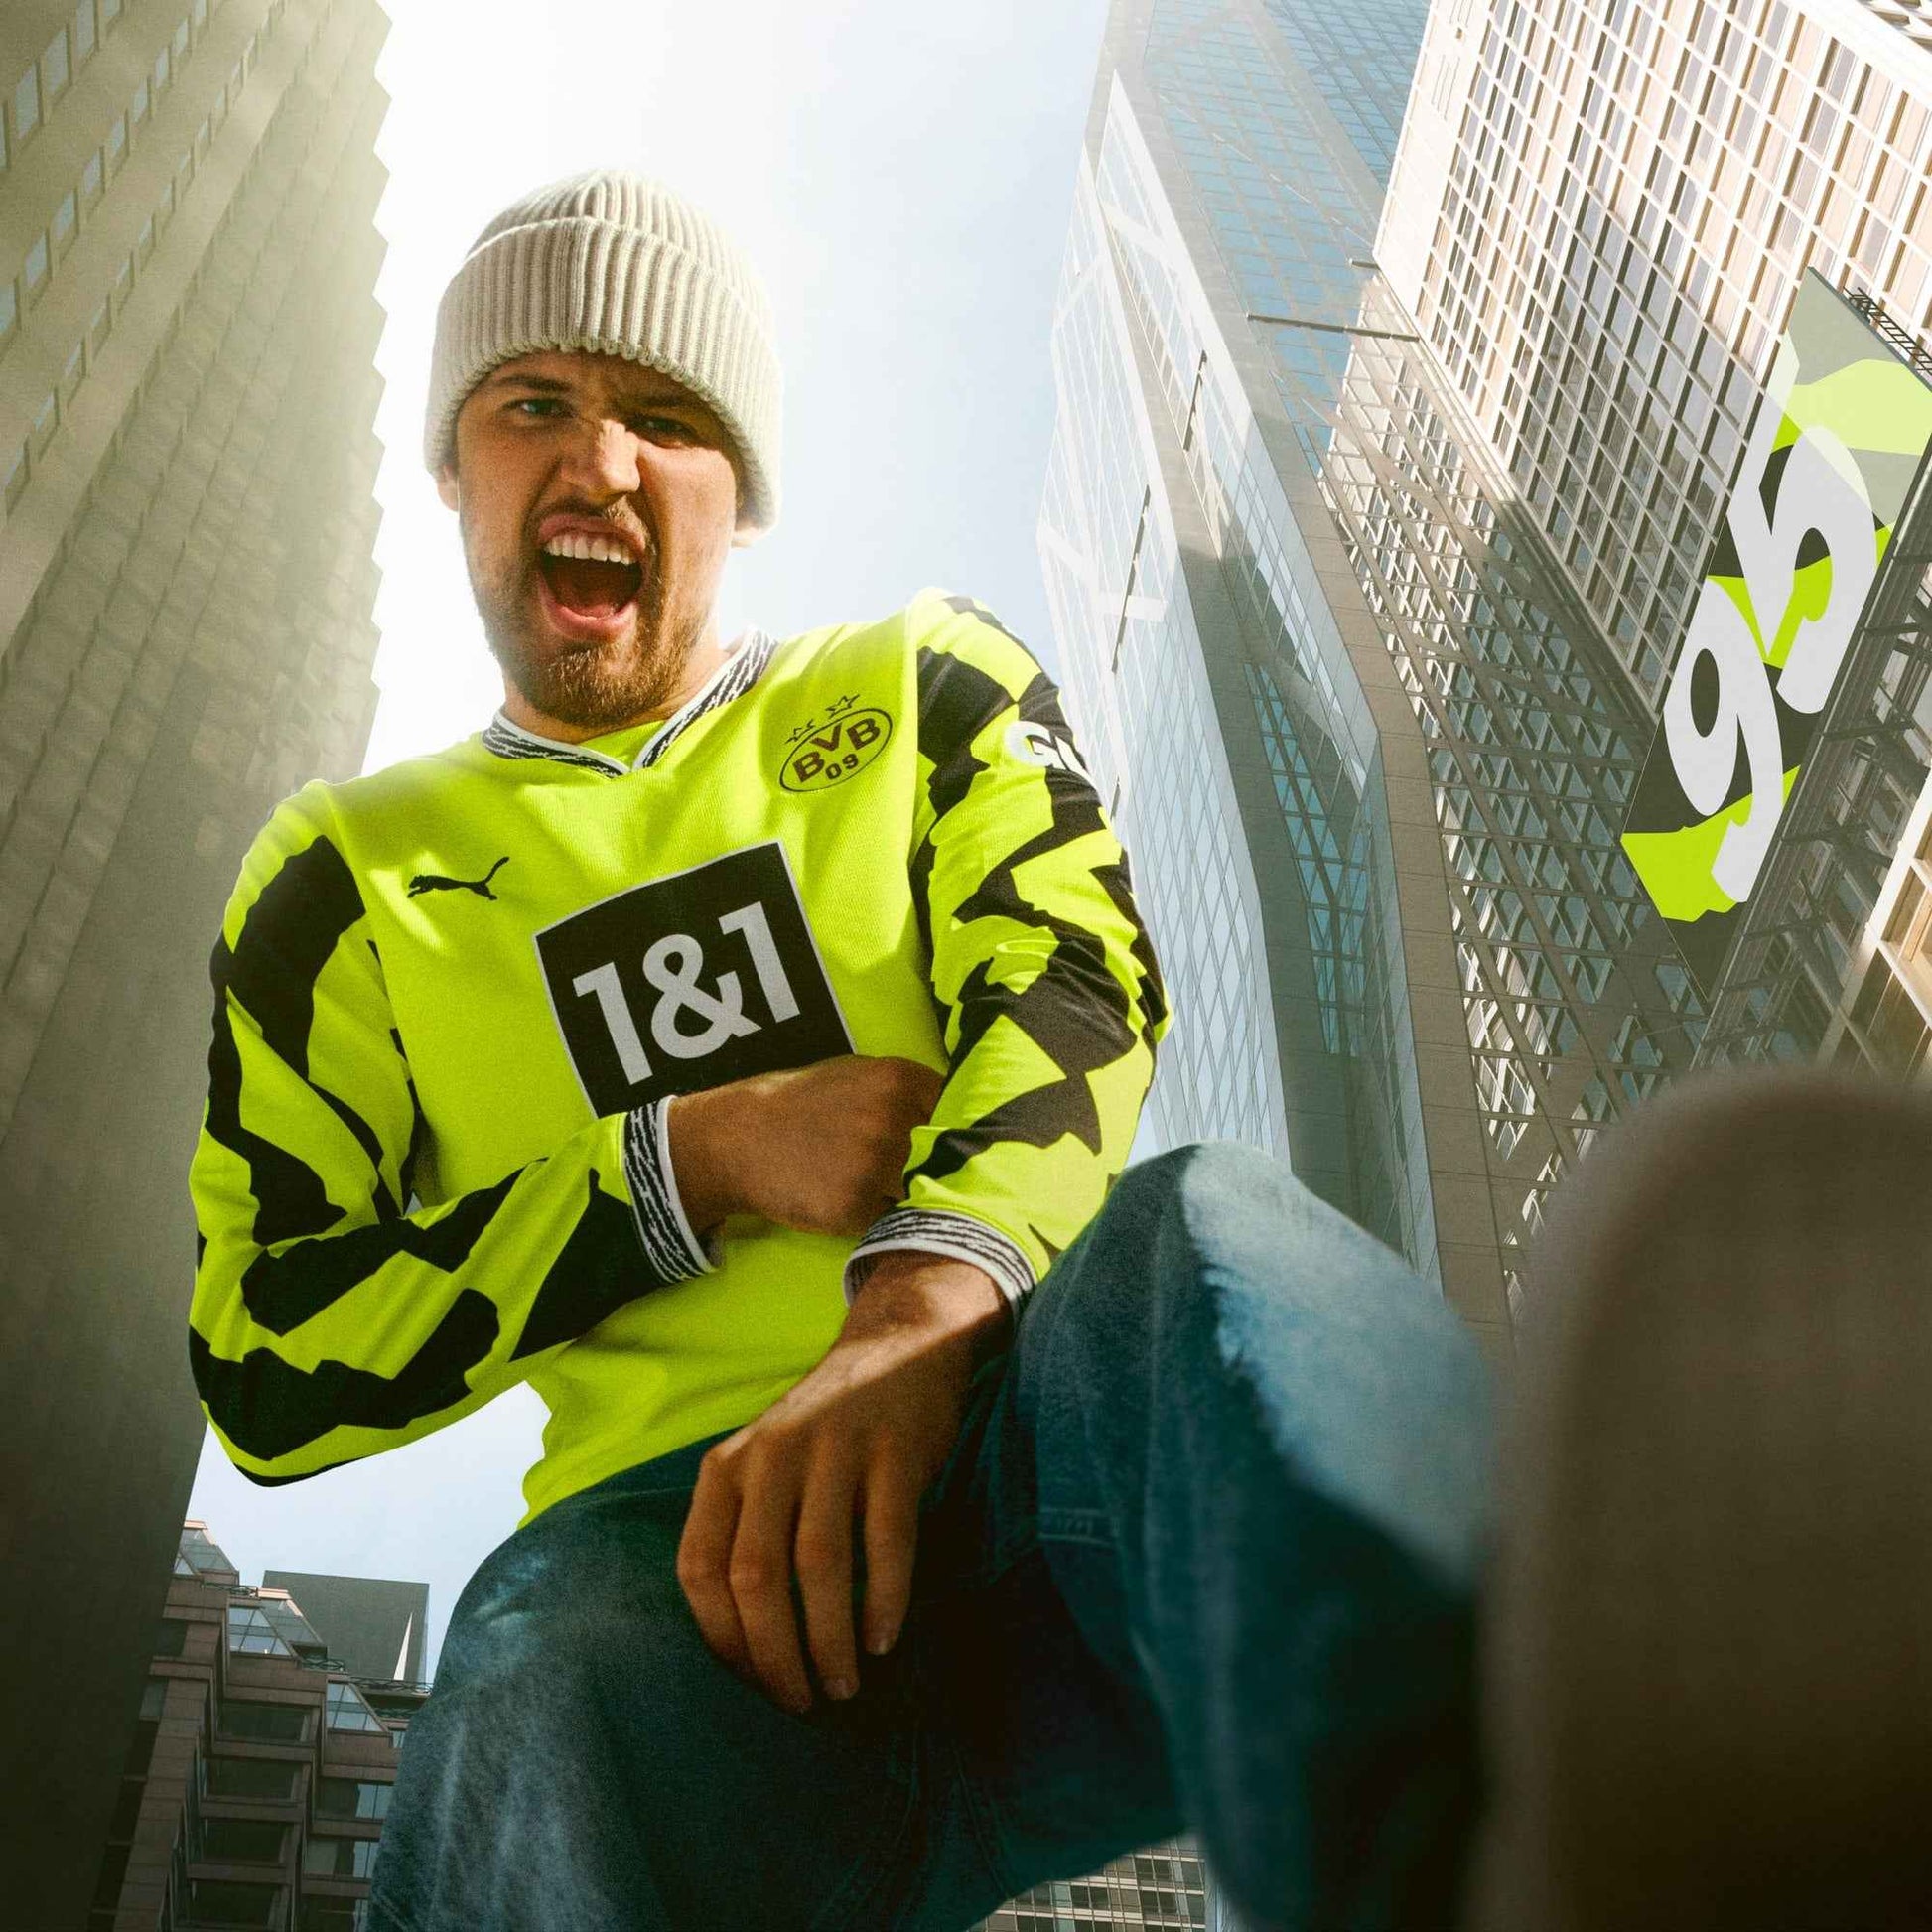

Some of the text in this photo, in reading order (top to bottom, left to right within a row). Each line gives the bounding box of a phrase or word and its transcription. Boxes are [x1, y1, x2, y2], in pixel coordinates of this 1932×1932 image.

[792, 717, 881, 783] BVB
[825, 753, 859, 780] 09
[572, 900, 801, 1086] 1&1
